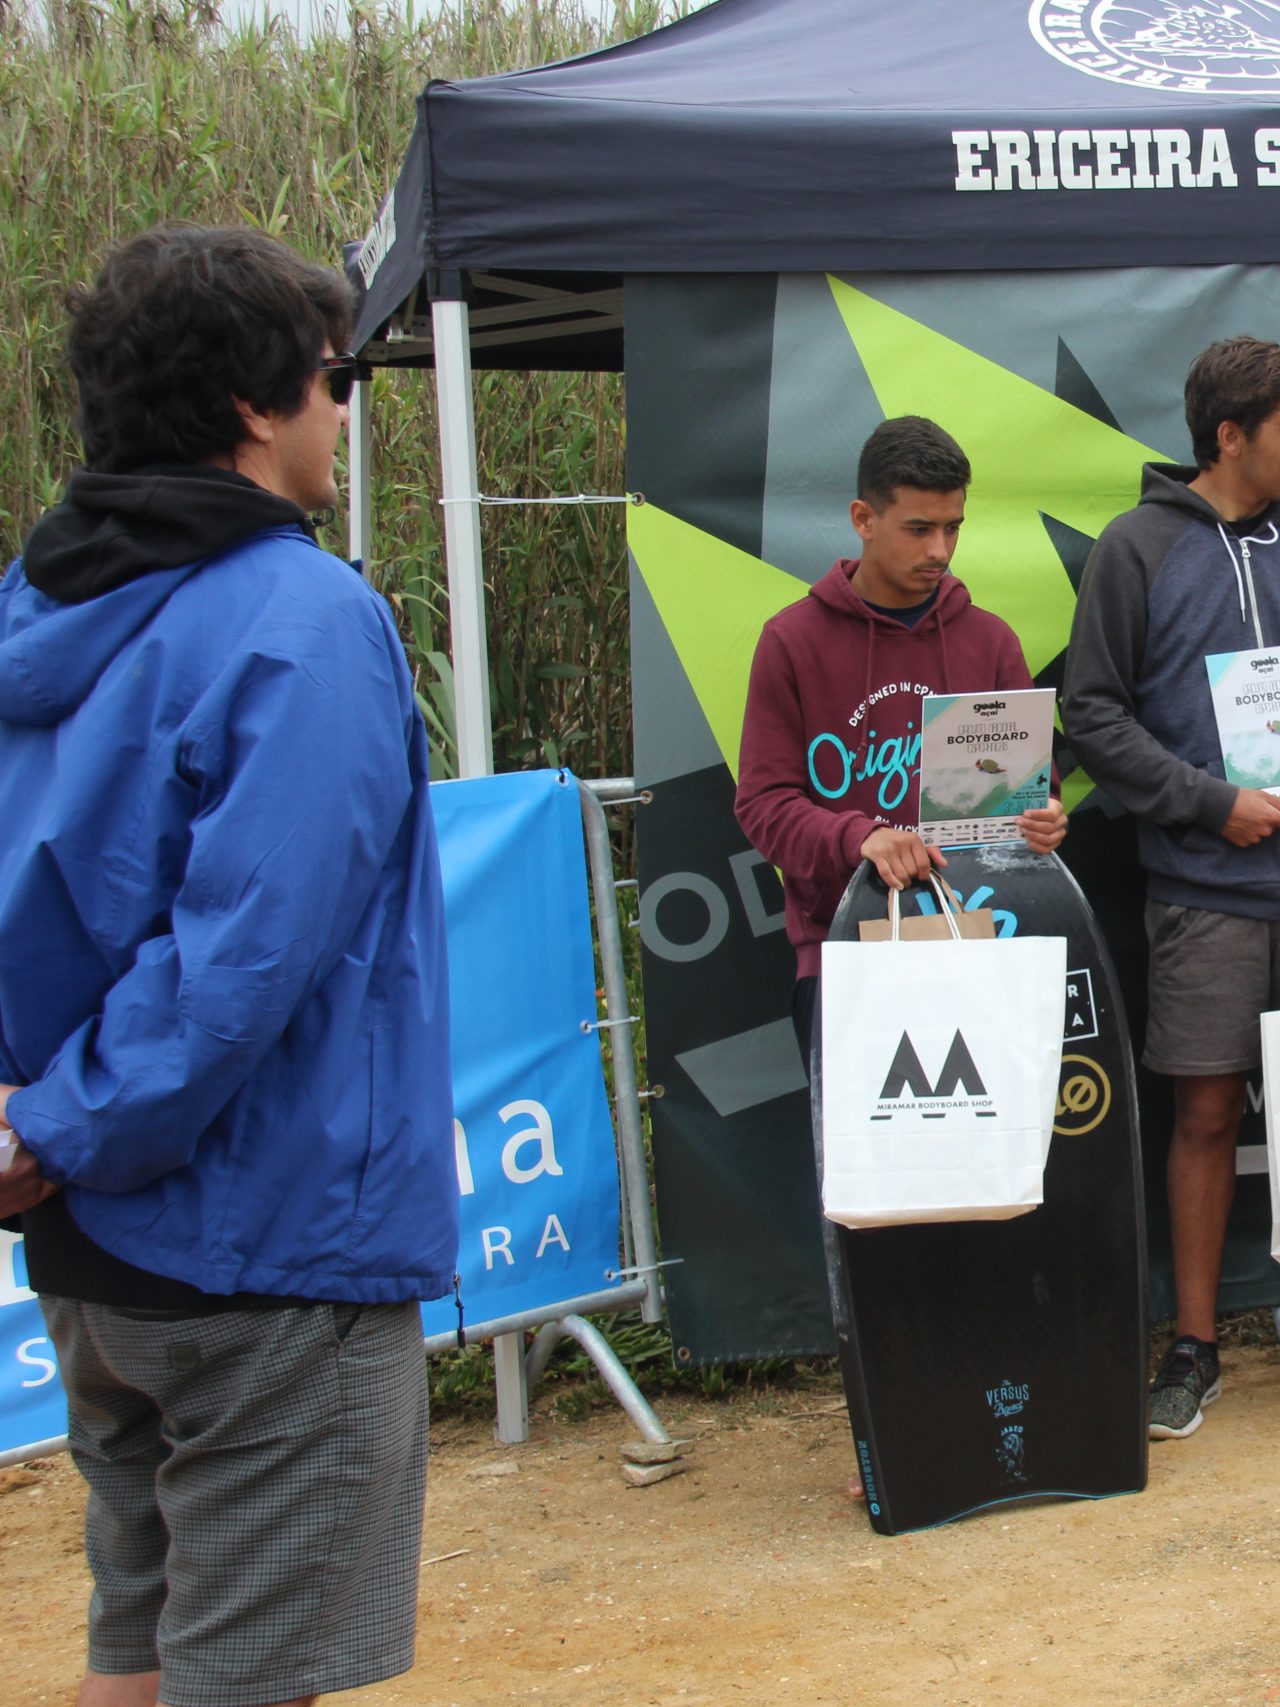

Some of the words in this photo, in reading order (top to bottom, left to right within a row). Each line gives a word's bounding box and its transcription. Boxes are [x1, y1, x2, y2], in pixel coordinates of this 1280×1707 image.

[951, 128, 1238, 191] ERICEIRA
[848, 683, 898, 728] DESGNED
[900, 681, 911, 692] IN
[947, 731, 1029, 745] BODYBOARD
[877, 1102, 916, 1111] MIRAMAR
[918, 1101, 969, 1109] BODYBOARD
[986, 1384, 1030, 1406] VERSUS
